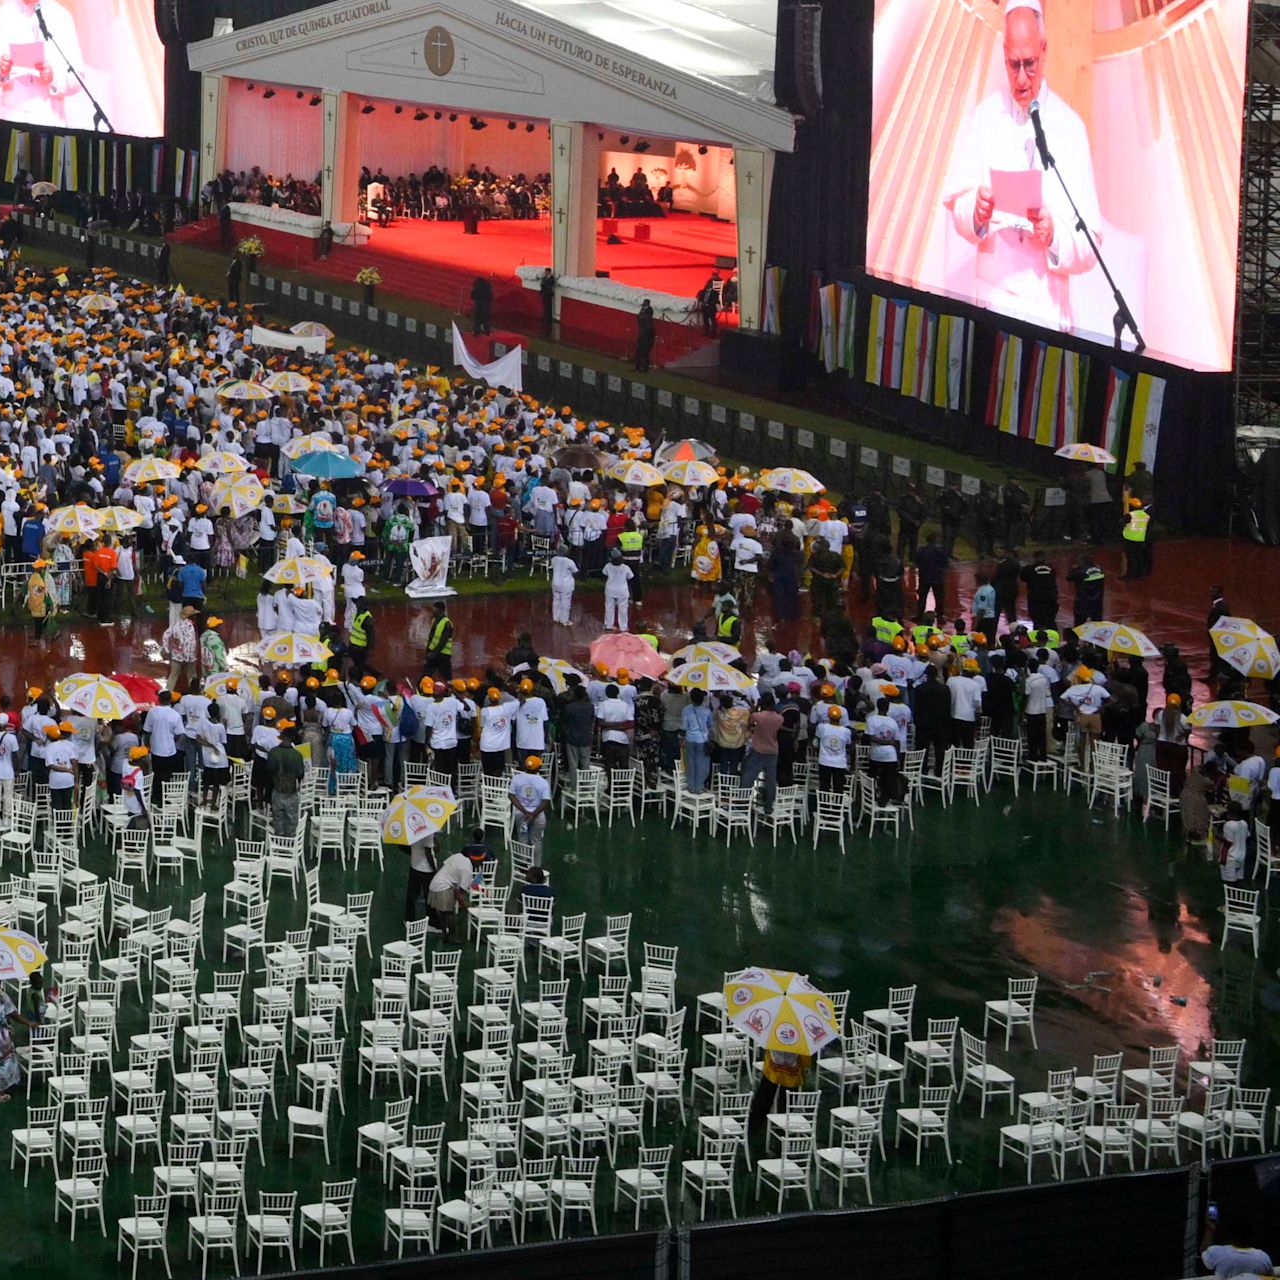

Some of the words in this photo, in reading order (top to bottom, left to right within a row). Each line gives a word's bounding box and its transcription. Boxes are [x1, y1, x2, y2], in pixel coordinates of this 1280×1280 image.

[235, 34, 269, 52] CRISTO,
[269, 28, 285, 45] LUZ
[286, 25, 298, 39] DE
[298, 17, 333, 36] GUINEA
[333, 0, 392, 25] ECUATORIAL
[495, 11, 528, 35] HACIA
[529, 26, 547, 43] UN
[547, 34, 593, 62] FUTURO
[594, 54, 610, 69] DE
[611, 62, 677, 100] ESPERANZA
